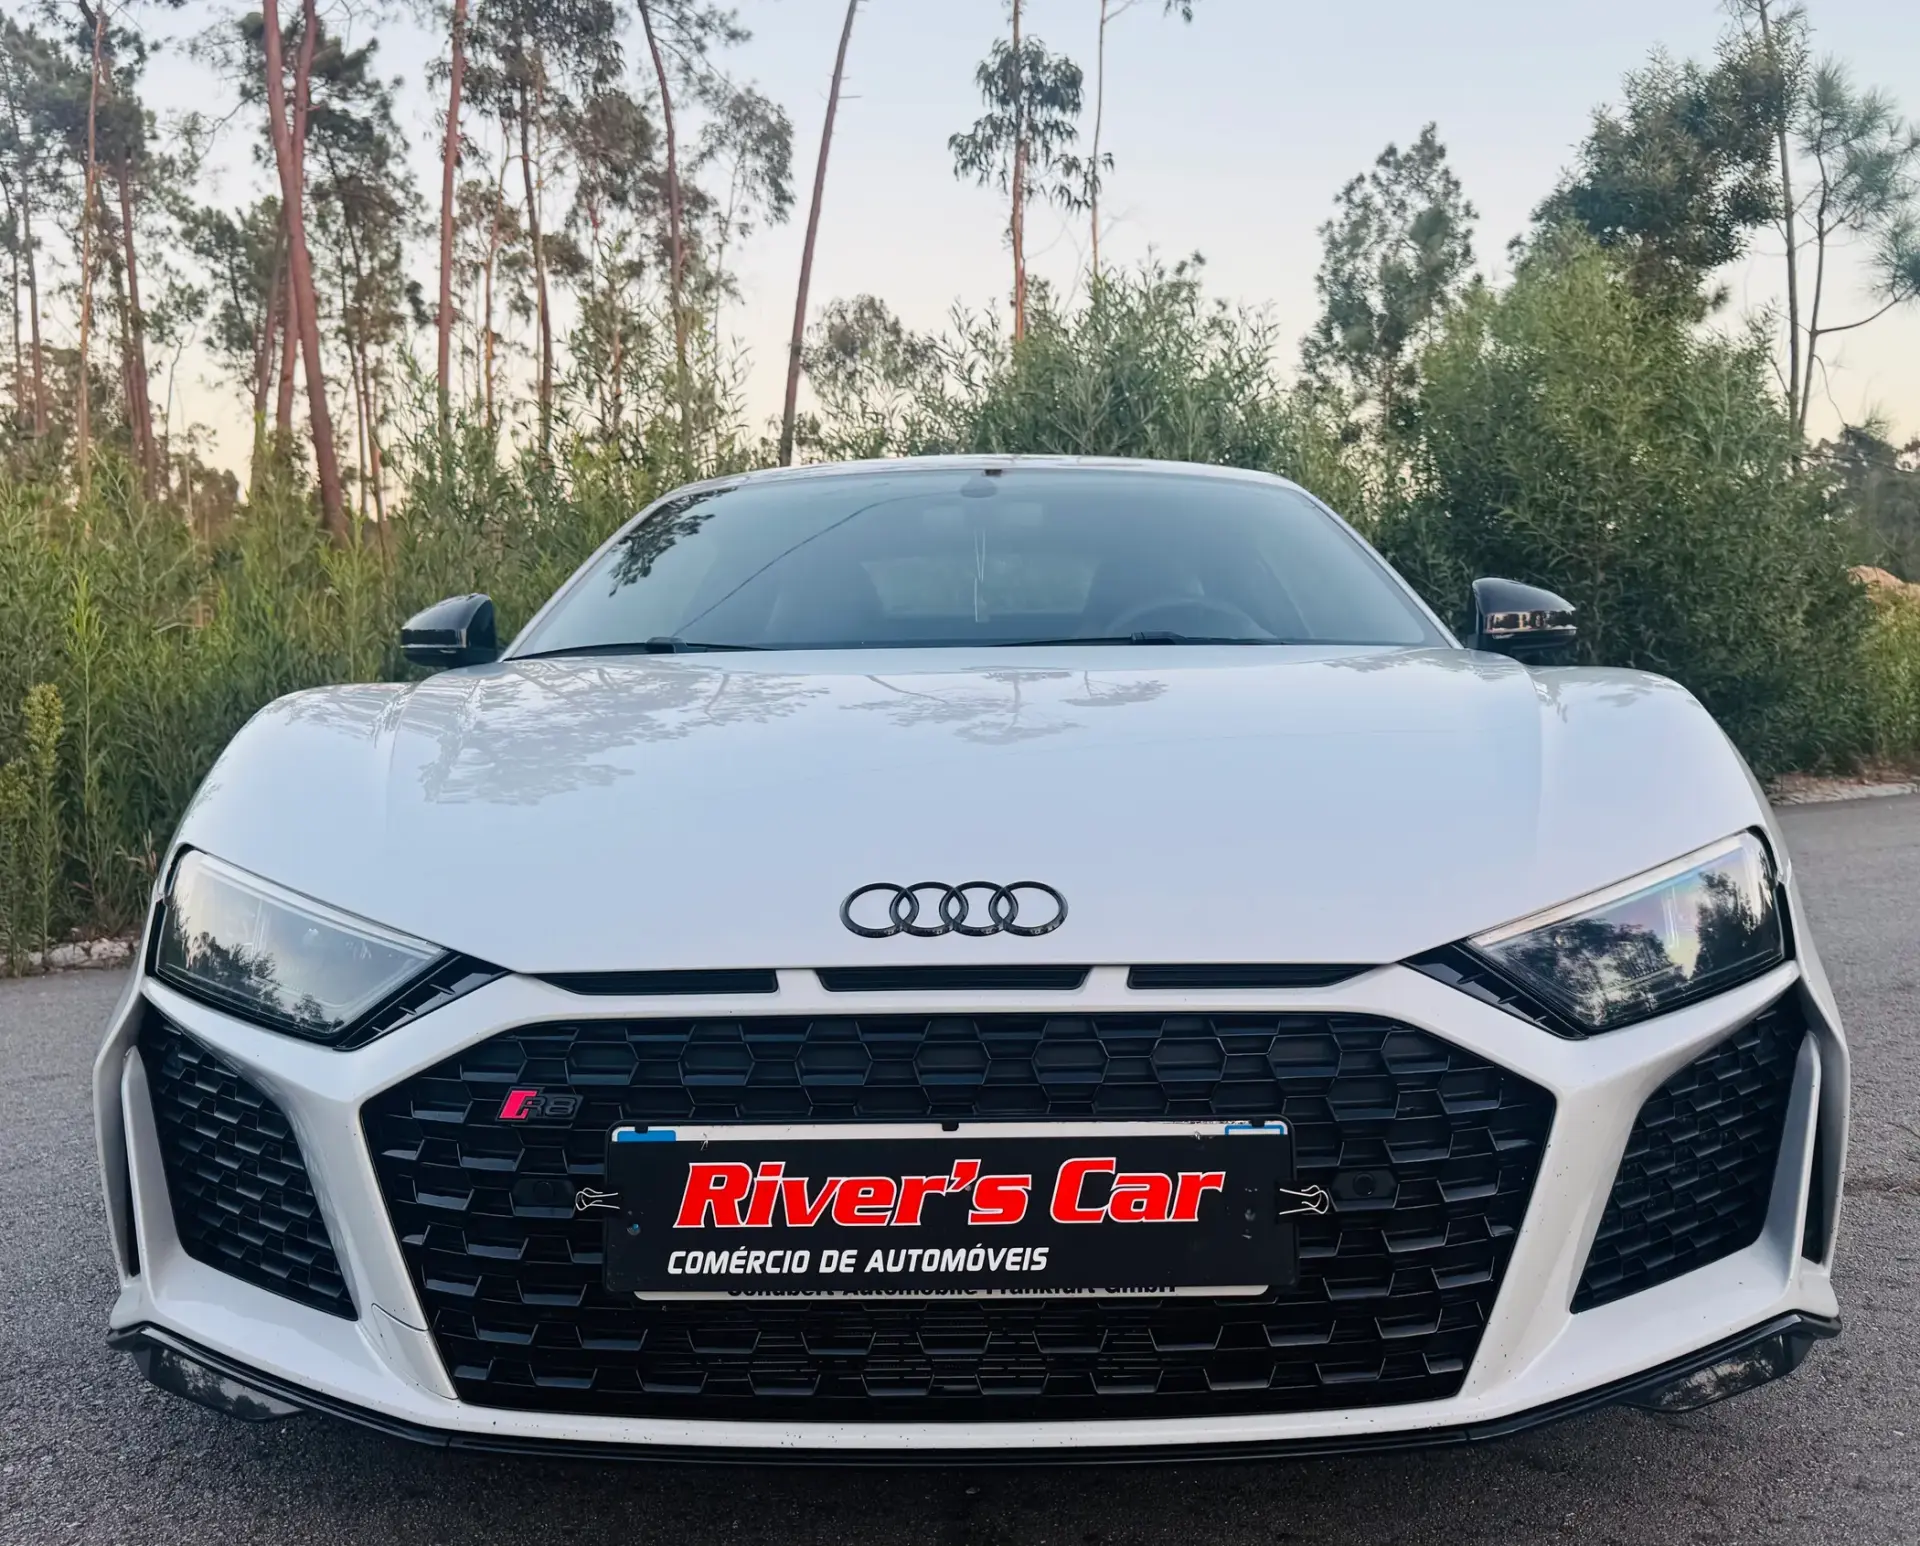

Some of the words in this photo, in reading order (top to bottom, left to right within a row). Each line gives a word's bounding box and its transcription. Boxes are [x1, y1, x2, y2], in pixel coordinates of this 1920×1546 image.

[498, 1089, 581, 1120] R8
[673, 1159, 1032, 1228] River's
[1050, 1157, 1226, 1224] Car
[667, 1245, 811, 1275] COMÉRCIO
[819, 1249, 858, 1274] DE
[864, 1243, 1050, 1274] AUTOMÓVEIS
